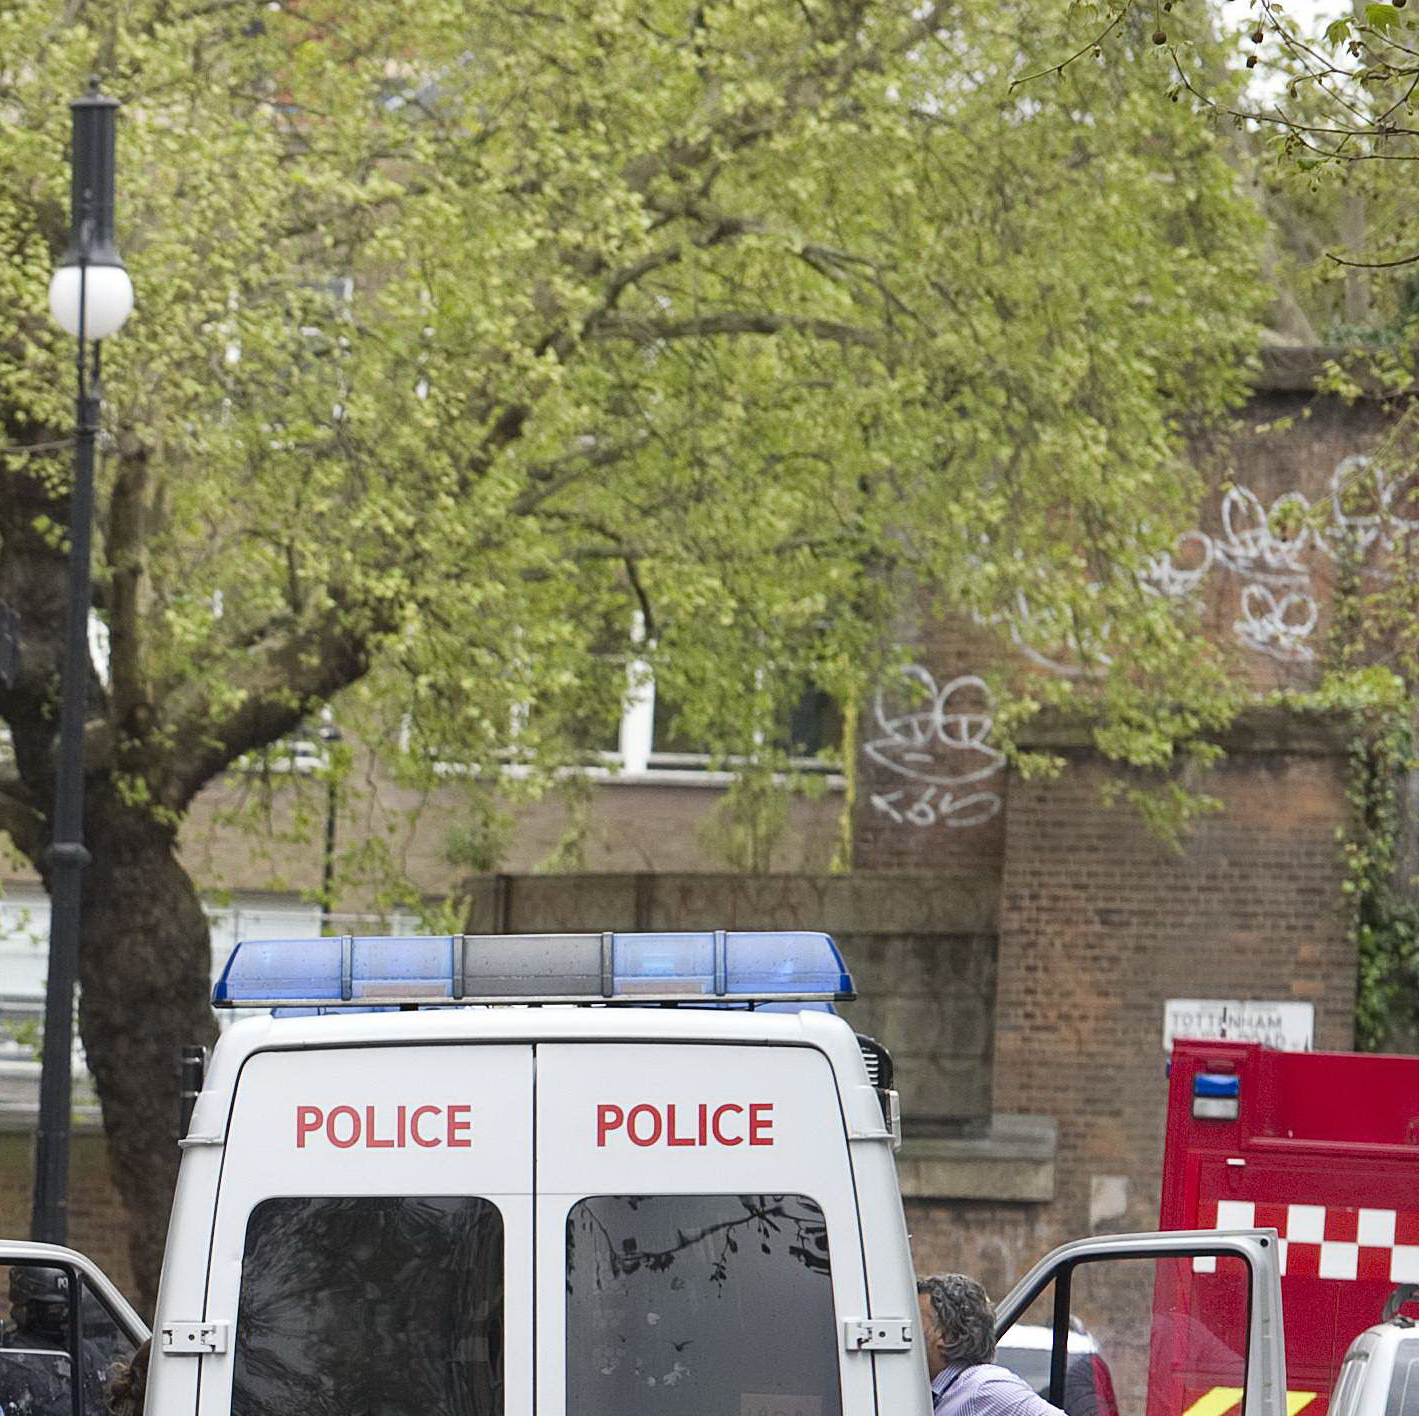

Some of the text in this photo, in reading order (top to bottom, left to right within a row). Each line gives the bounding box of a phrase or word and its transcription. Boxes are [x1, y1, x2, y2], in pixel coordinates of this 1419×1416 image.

[1172, 1010, 1282, 1029] TOTTNHAM
[295, 1104, 472, 1148] POLICE
[596, 1103, 774, 1147] POLICE
